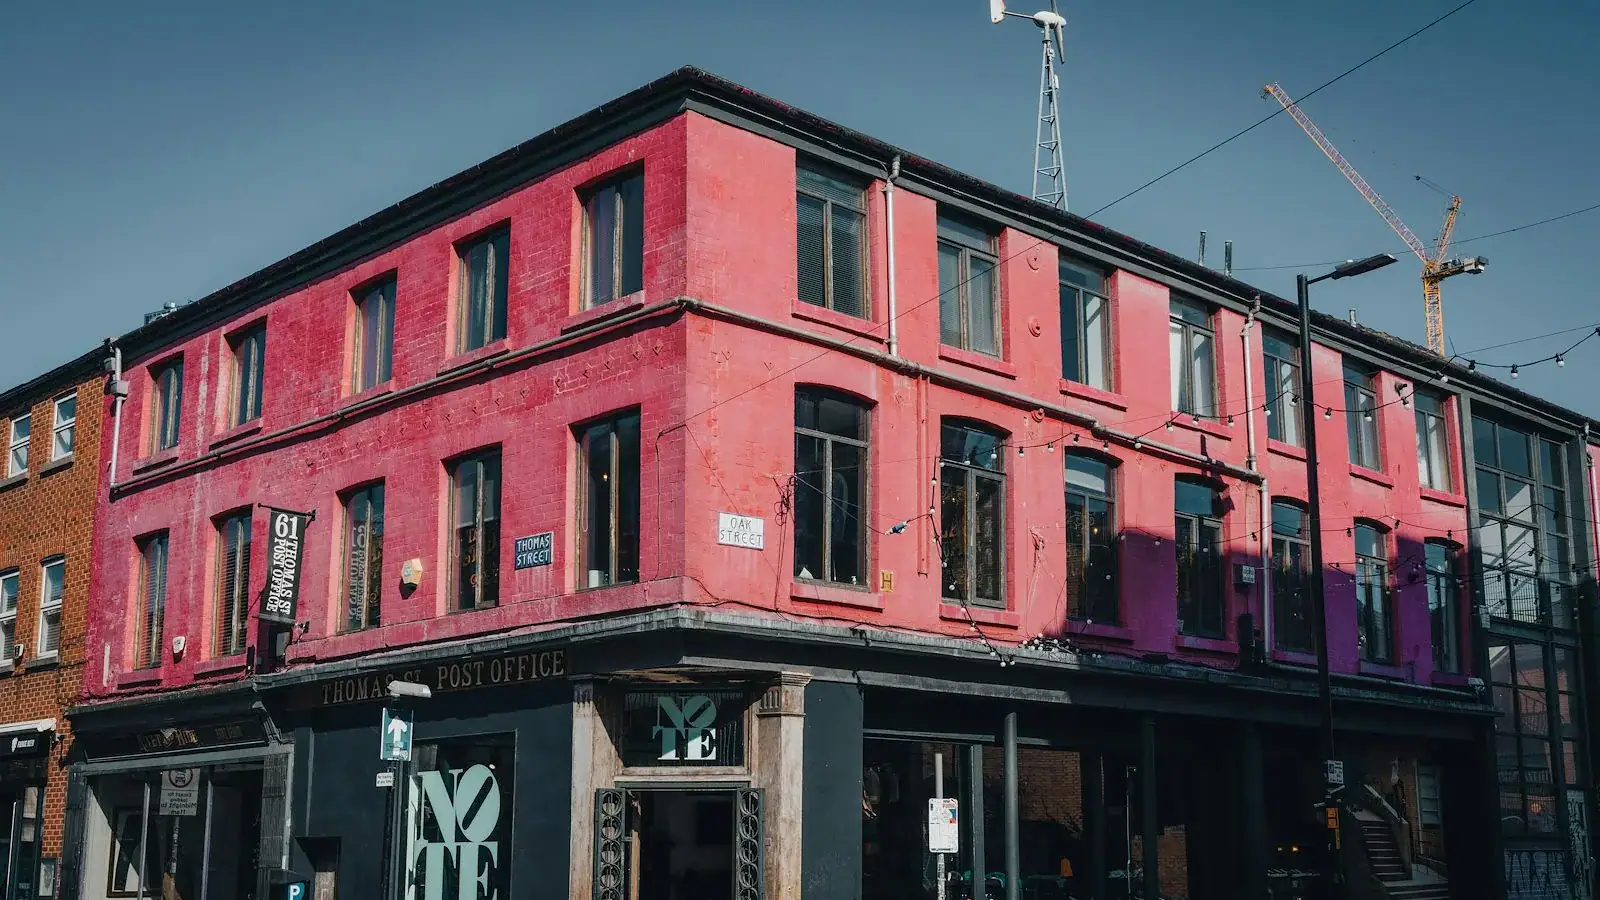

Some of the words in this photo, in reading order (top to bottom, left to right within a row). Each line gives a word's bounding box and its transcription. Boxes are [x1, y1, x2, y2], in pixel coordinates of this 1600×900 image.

[275, 513, 298, 540] 61
[730, 517, 752, 531] OAK
[517, 535, 550, 552] THOMAS
[720, 529, 762, 546] STREET
[273, 537, 287, 568] POST
[517, 550, 550, 566] STREET
[280, 540, 298, 598] THOMAS
[266, 569, 283, 613] OFFICE
[881, 571, 892, 591] H
[437, 660, 485, 690] POST
[491, 650, 565, 684] OFFICE
[289, 885, 301, 900] P
